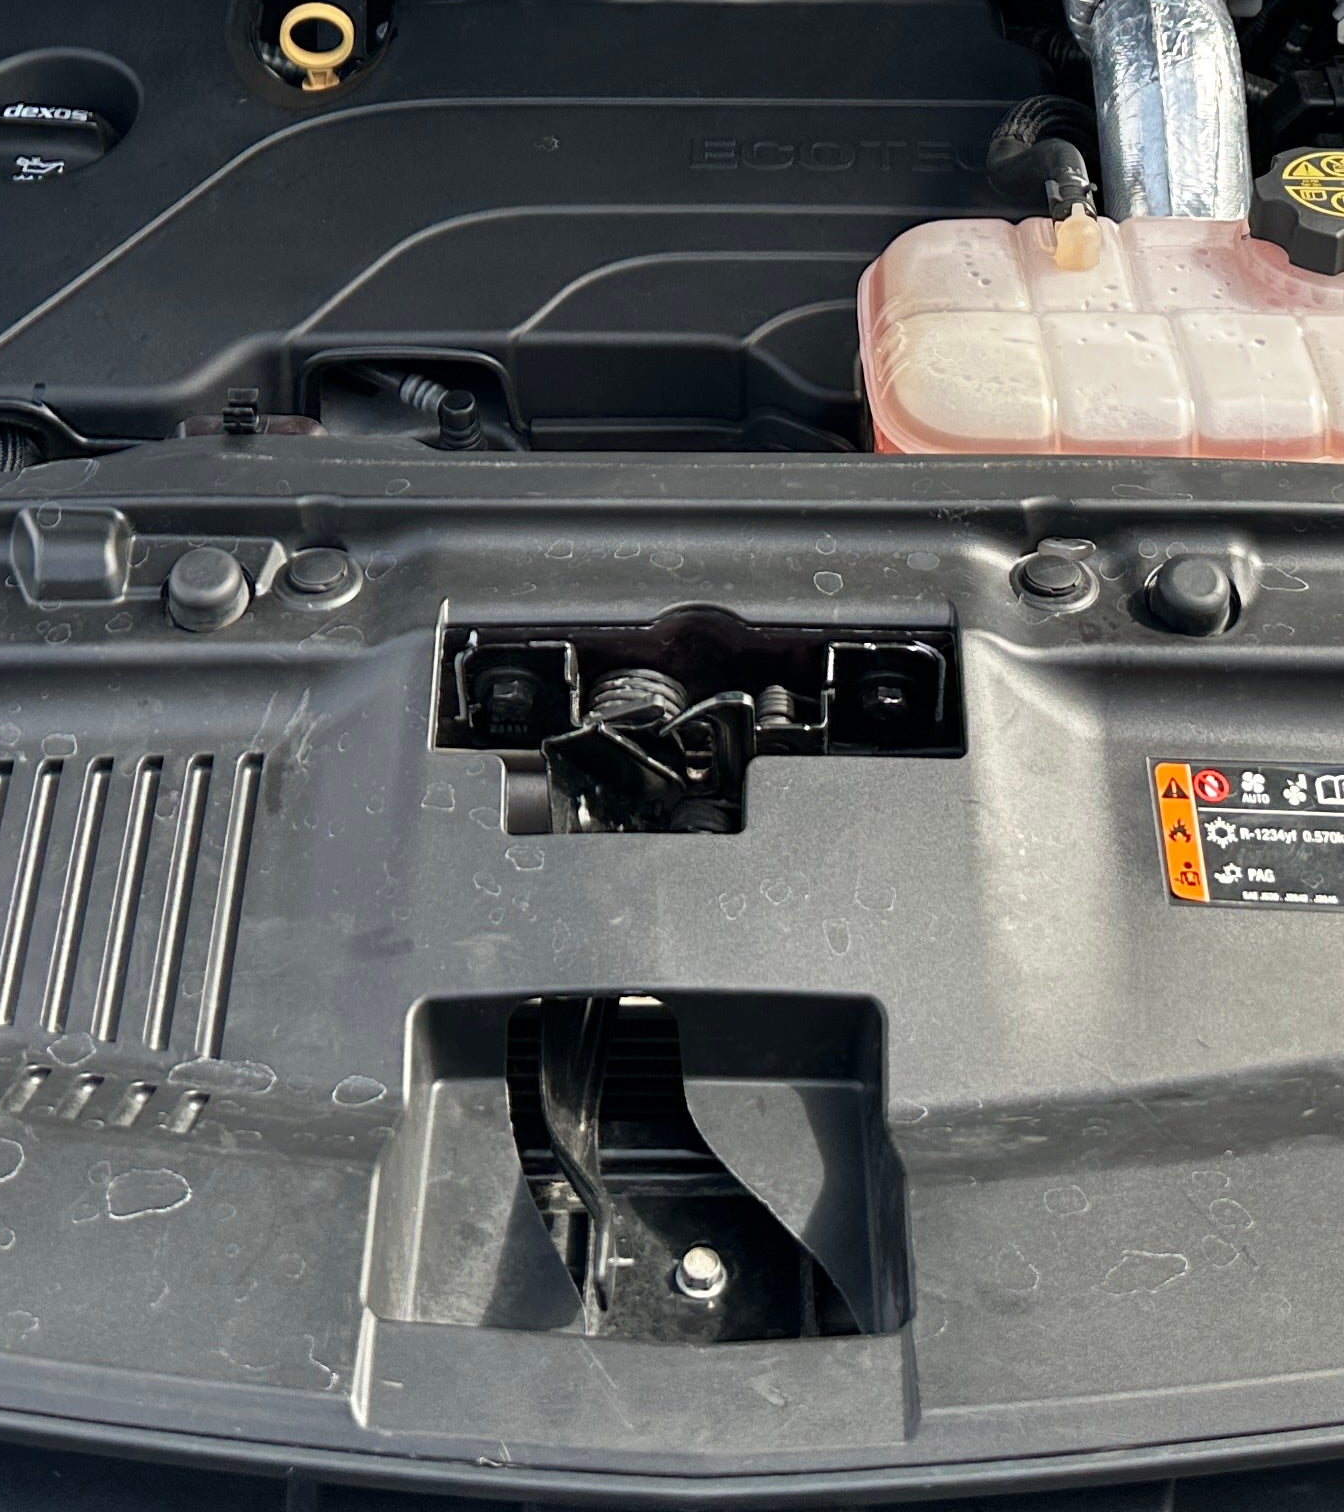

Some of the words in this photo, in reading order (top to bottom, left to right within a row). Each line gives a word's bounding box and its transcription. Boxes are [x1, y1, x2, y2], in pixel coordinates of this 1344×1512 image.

[3, 102, 89, 121] dexos
[1241, 793, 1271, 805] AUTO
[1240, 827, 1298, 843] R-1234yf
[1247, 868, 1276, 883] PAG
